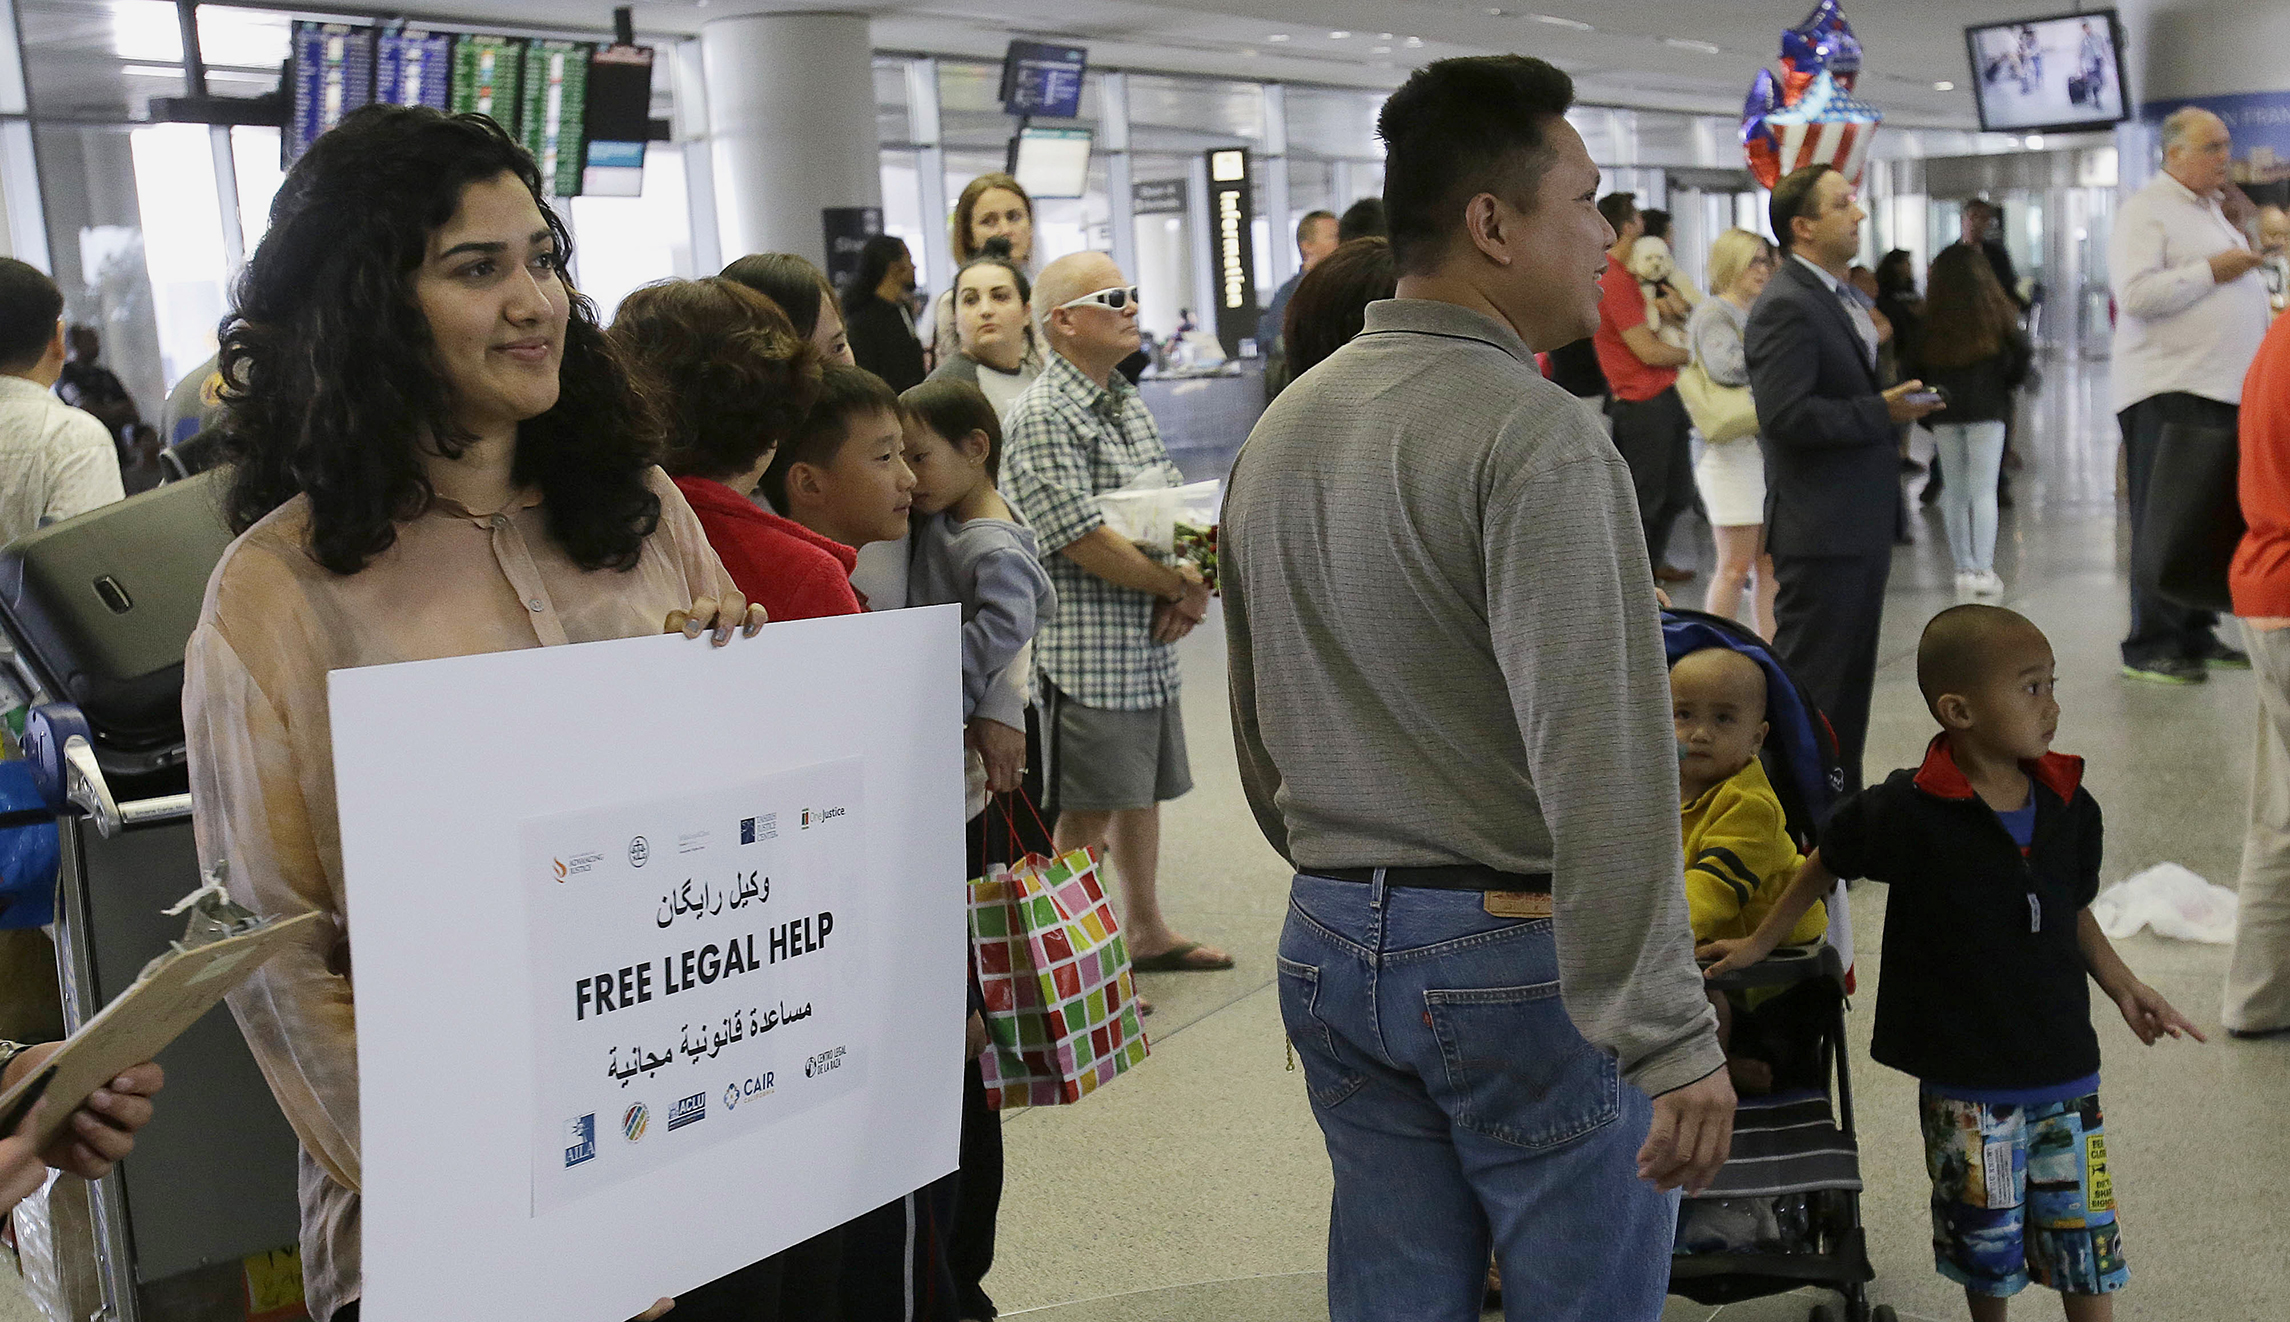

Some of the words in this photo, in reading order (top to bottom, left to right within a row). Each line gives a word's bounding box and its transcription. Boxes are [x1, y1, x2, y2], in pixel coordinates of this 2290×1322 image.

[1219, 190, 1245, 308] Information
[809, 806, 846, 823] OneJustice
[576, 962, 652, 1021] FREE
[664, 933, 760, 996] LEGAL
[769, 911, 834, 965] HELP
[680, 1009, 743, 1065] قانونية
[749, 1000, 812, 1038] مساعدة
[608, 1046, 673, 1088] مجانية
[744, 1071, 775, 1096] CAIR
[678, 1092, 705, 1116] ACLU
[565, 1141, 596, 1163] AILA
